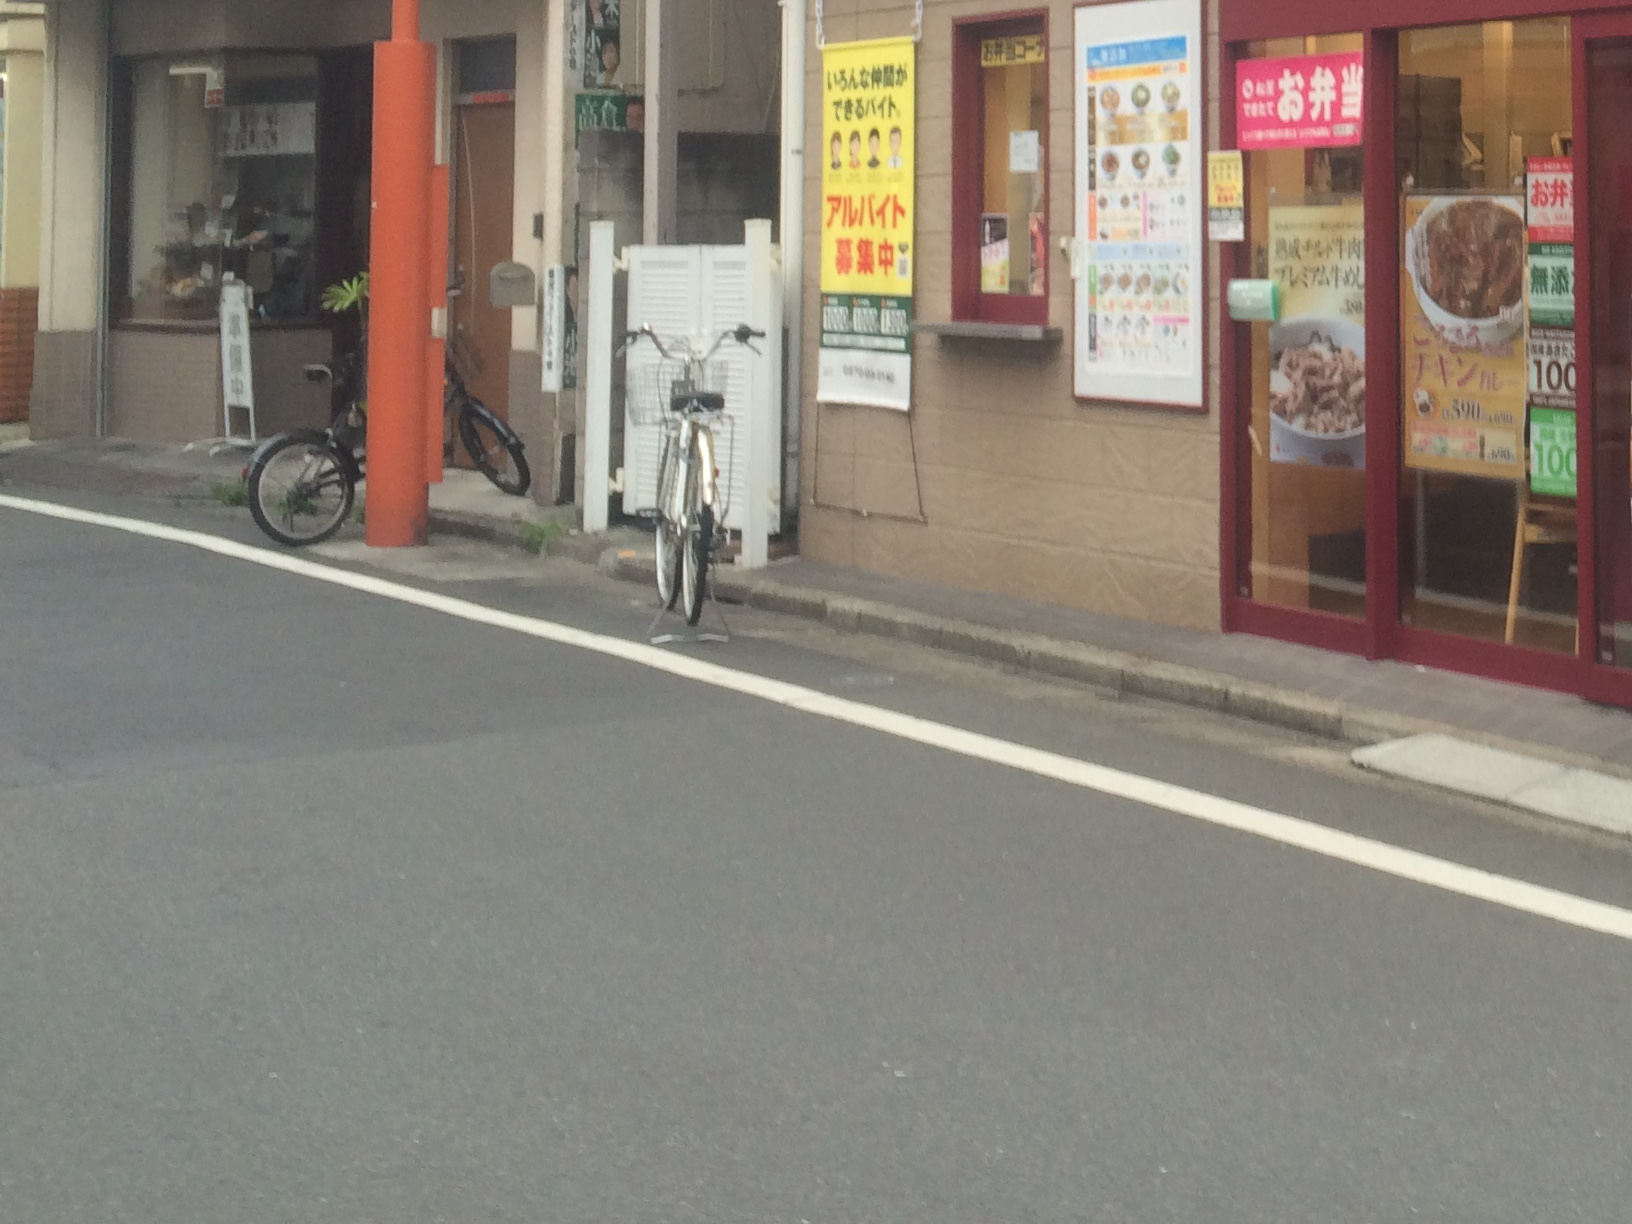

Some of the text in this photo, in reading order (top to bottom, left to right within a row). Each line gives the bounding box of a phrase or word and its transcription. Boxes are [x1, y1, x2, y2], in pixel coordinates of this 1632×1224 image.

[1277, 63, 1363, 123] お弁当
[826, 192, 906, 229] アルバイト
[1530, 178, 1573, 208] お弁
[835, 238, 894, 276] 募集中
[1531, 263, 1574, 295] 無添
